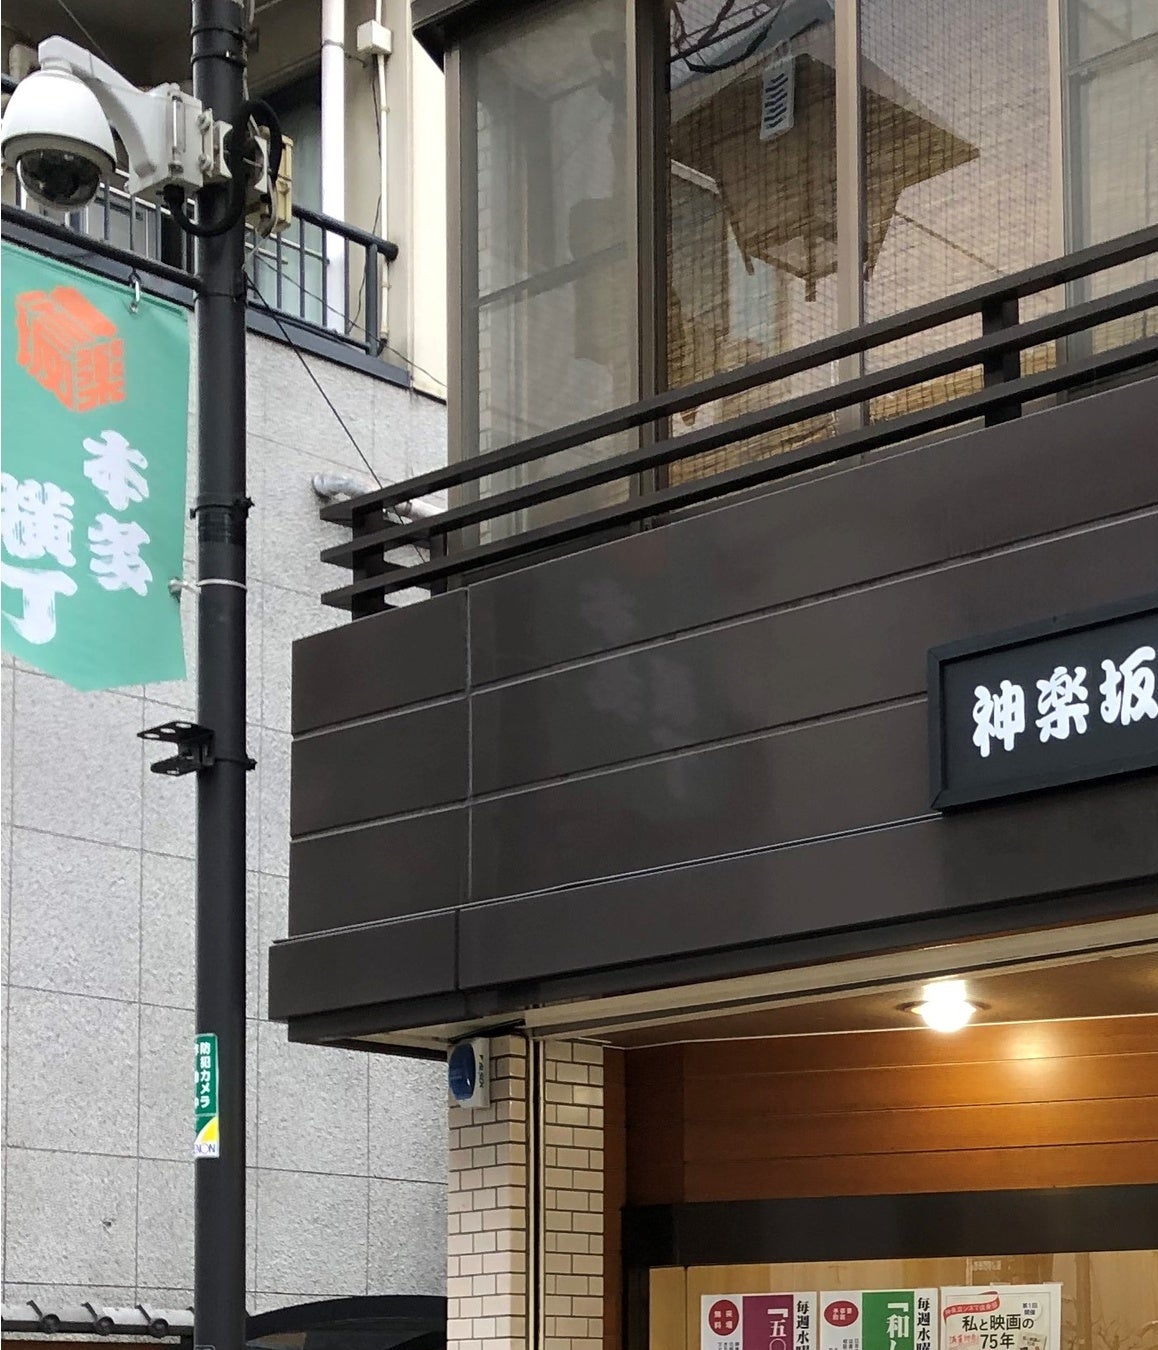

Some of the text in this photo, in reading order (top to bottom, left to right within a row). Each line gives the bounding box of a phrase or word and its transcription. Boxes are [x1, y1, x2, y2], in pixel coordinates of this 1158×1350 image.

[200, 1041, 211, 1109] 防犯カメラ
[961, 1314, 1034, 1332] 私と映画の
[980, 1332, 1015, 1350] 75年
